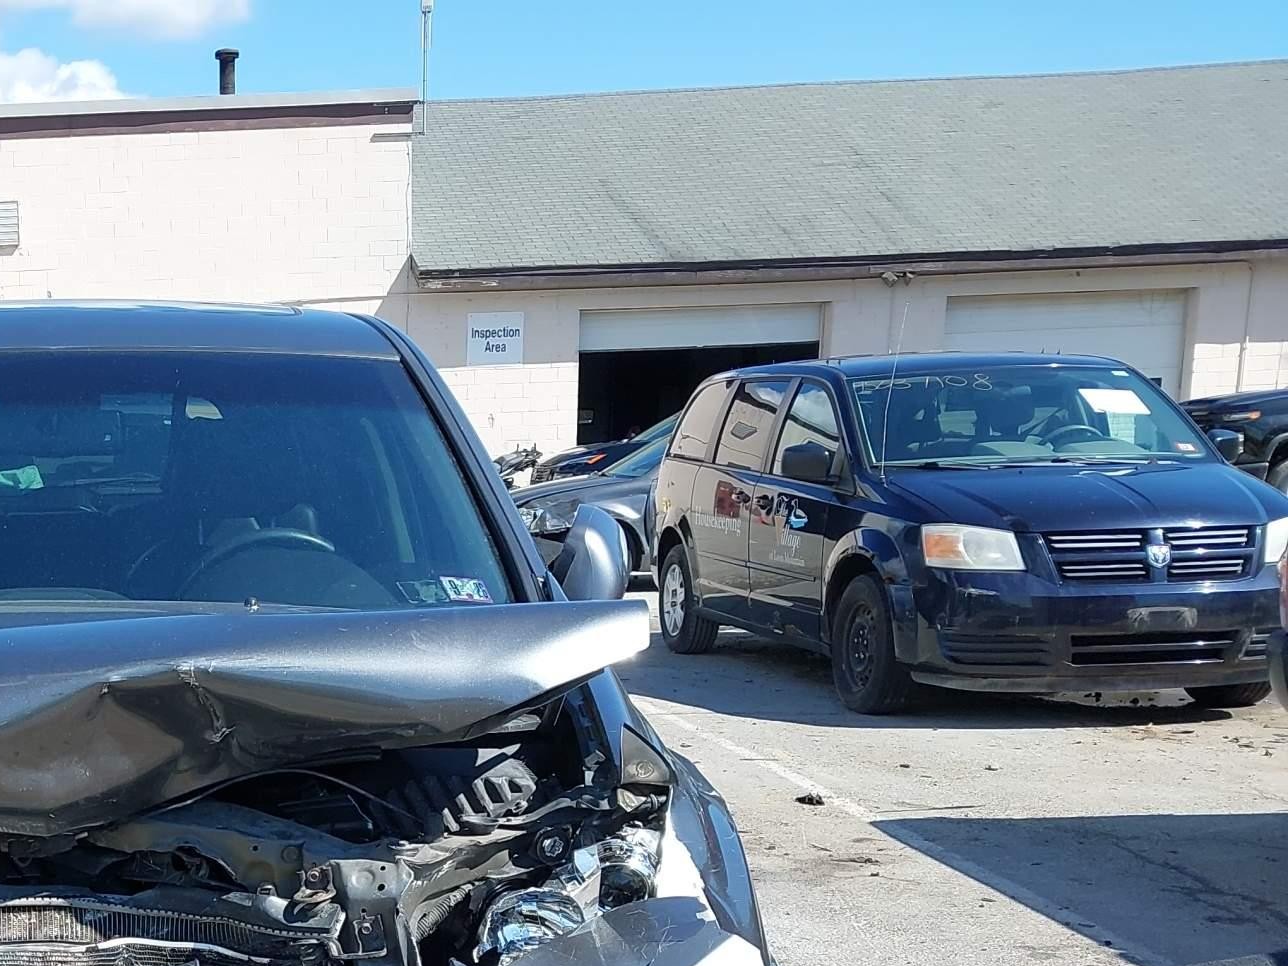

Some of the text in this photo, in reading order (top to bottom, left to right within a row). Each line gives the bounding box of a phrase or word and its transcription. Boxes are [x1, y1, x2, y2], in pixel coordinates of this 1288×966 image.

[471, 326, 521, 341] Inspection
[484, 340, 507, 353] Area
[695, 505, 742, 537] Housekeeping
